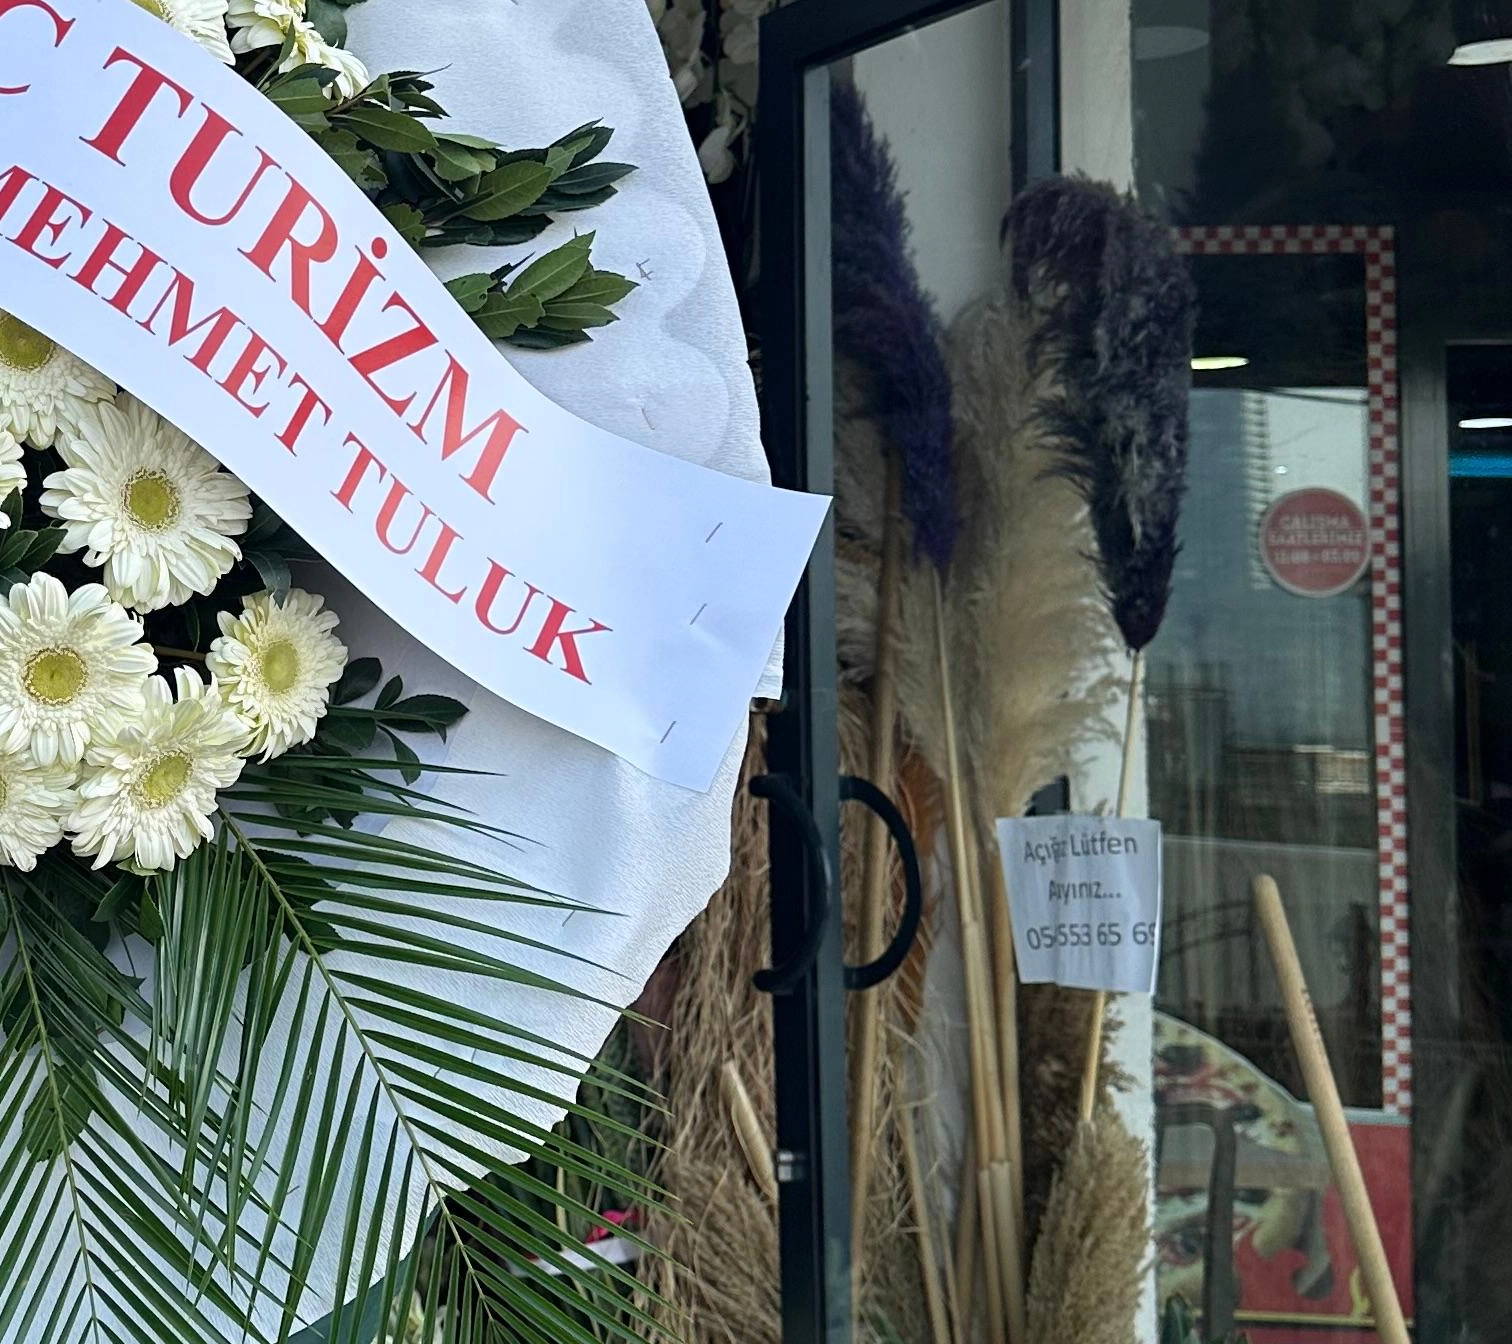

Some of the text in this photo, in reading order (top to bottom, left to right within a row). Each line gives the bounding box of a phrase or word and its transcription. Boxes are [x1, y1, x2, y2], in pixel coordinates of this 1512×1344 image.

[80, 46, 529, 506] TURİZM
[331, 430, 614, 685] TULUK
[1070, 830, 1138, 857] Lütfen
[1097, 922, 1121, 946] 65
